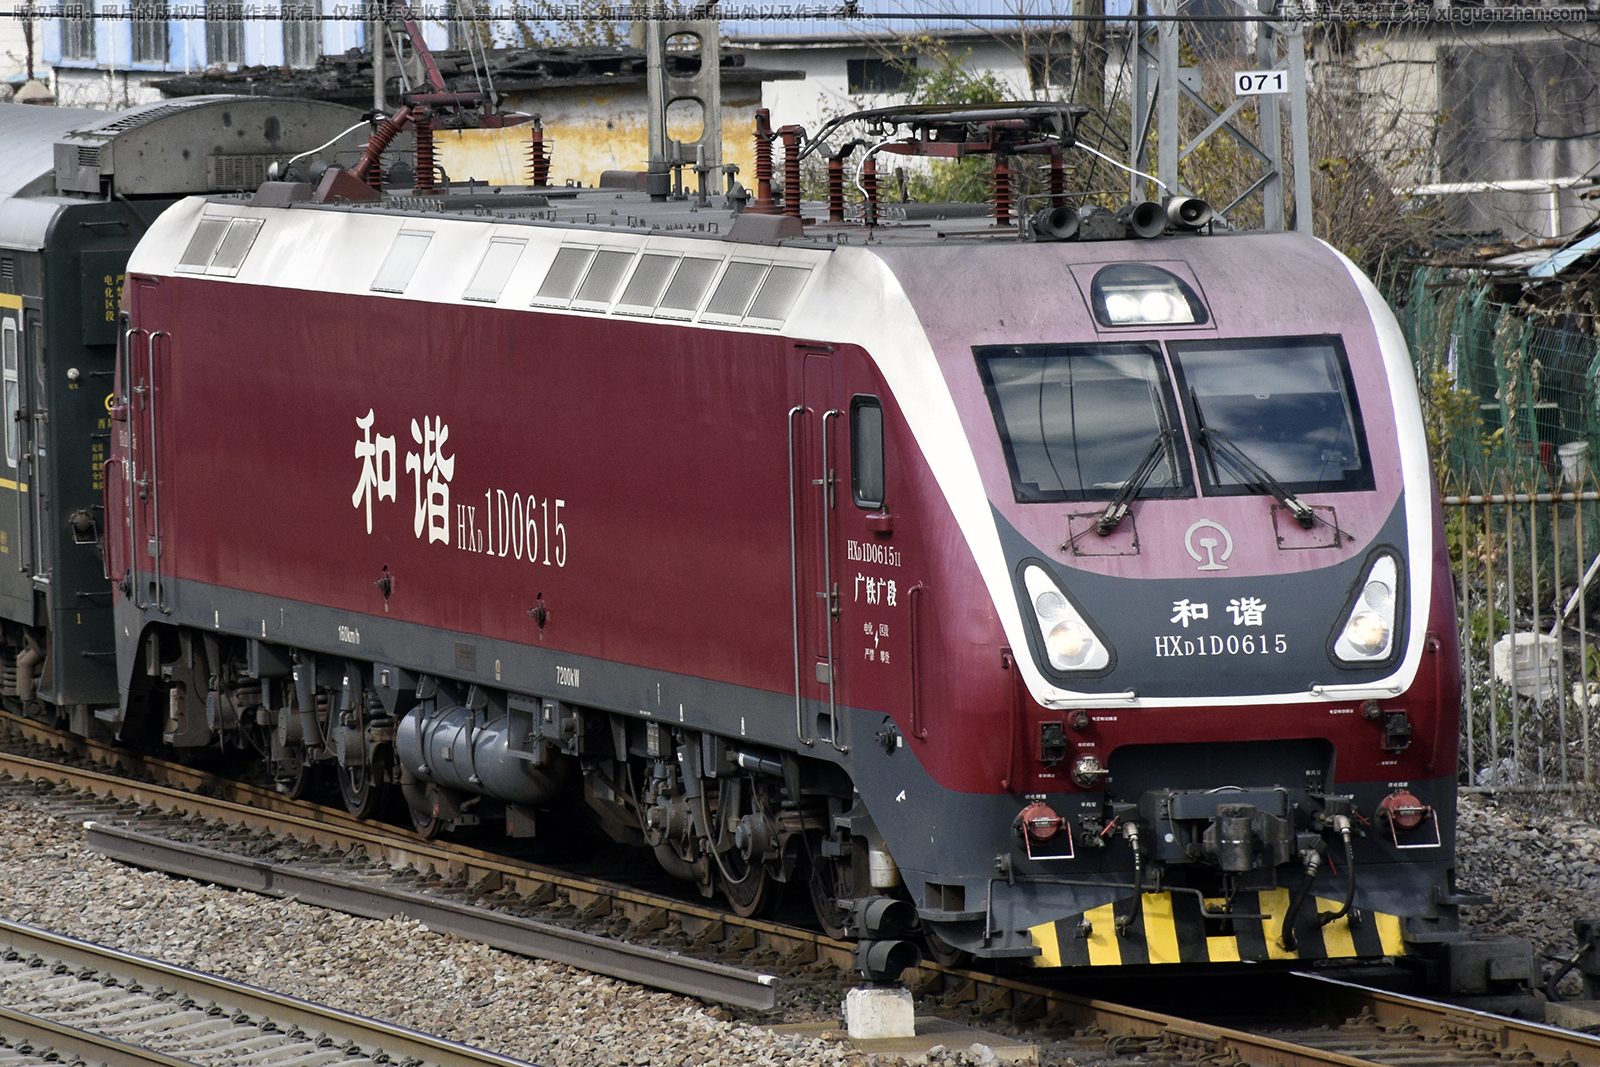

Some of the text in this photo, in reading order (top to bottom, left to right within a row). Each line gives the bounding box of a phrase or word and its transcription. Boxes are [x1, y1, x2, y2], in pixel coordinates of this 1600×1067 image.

[1238, 74, 1282, 91] 071
[352, 408, 566, 567] 和谐 HXD1D0615
[854, 572, 897, 607] 广铁广段
[1170, 597, 1267, 628] 和谐
[1154, 634, 1288, 657] HXD1D0615
[556, 665, 580, 688] 7200kW
